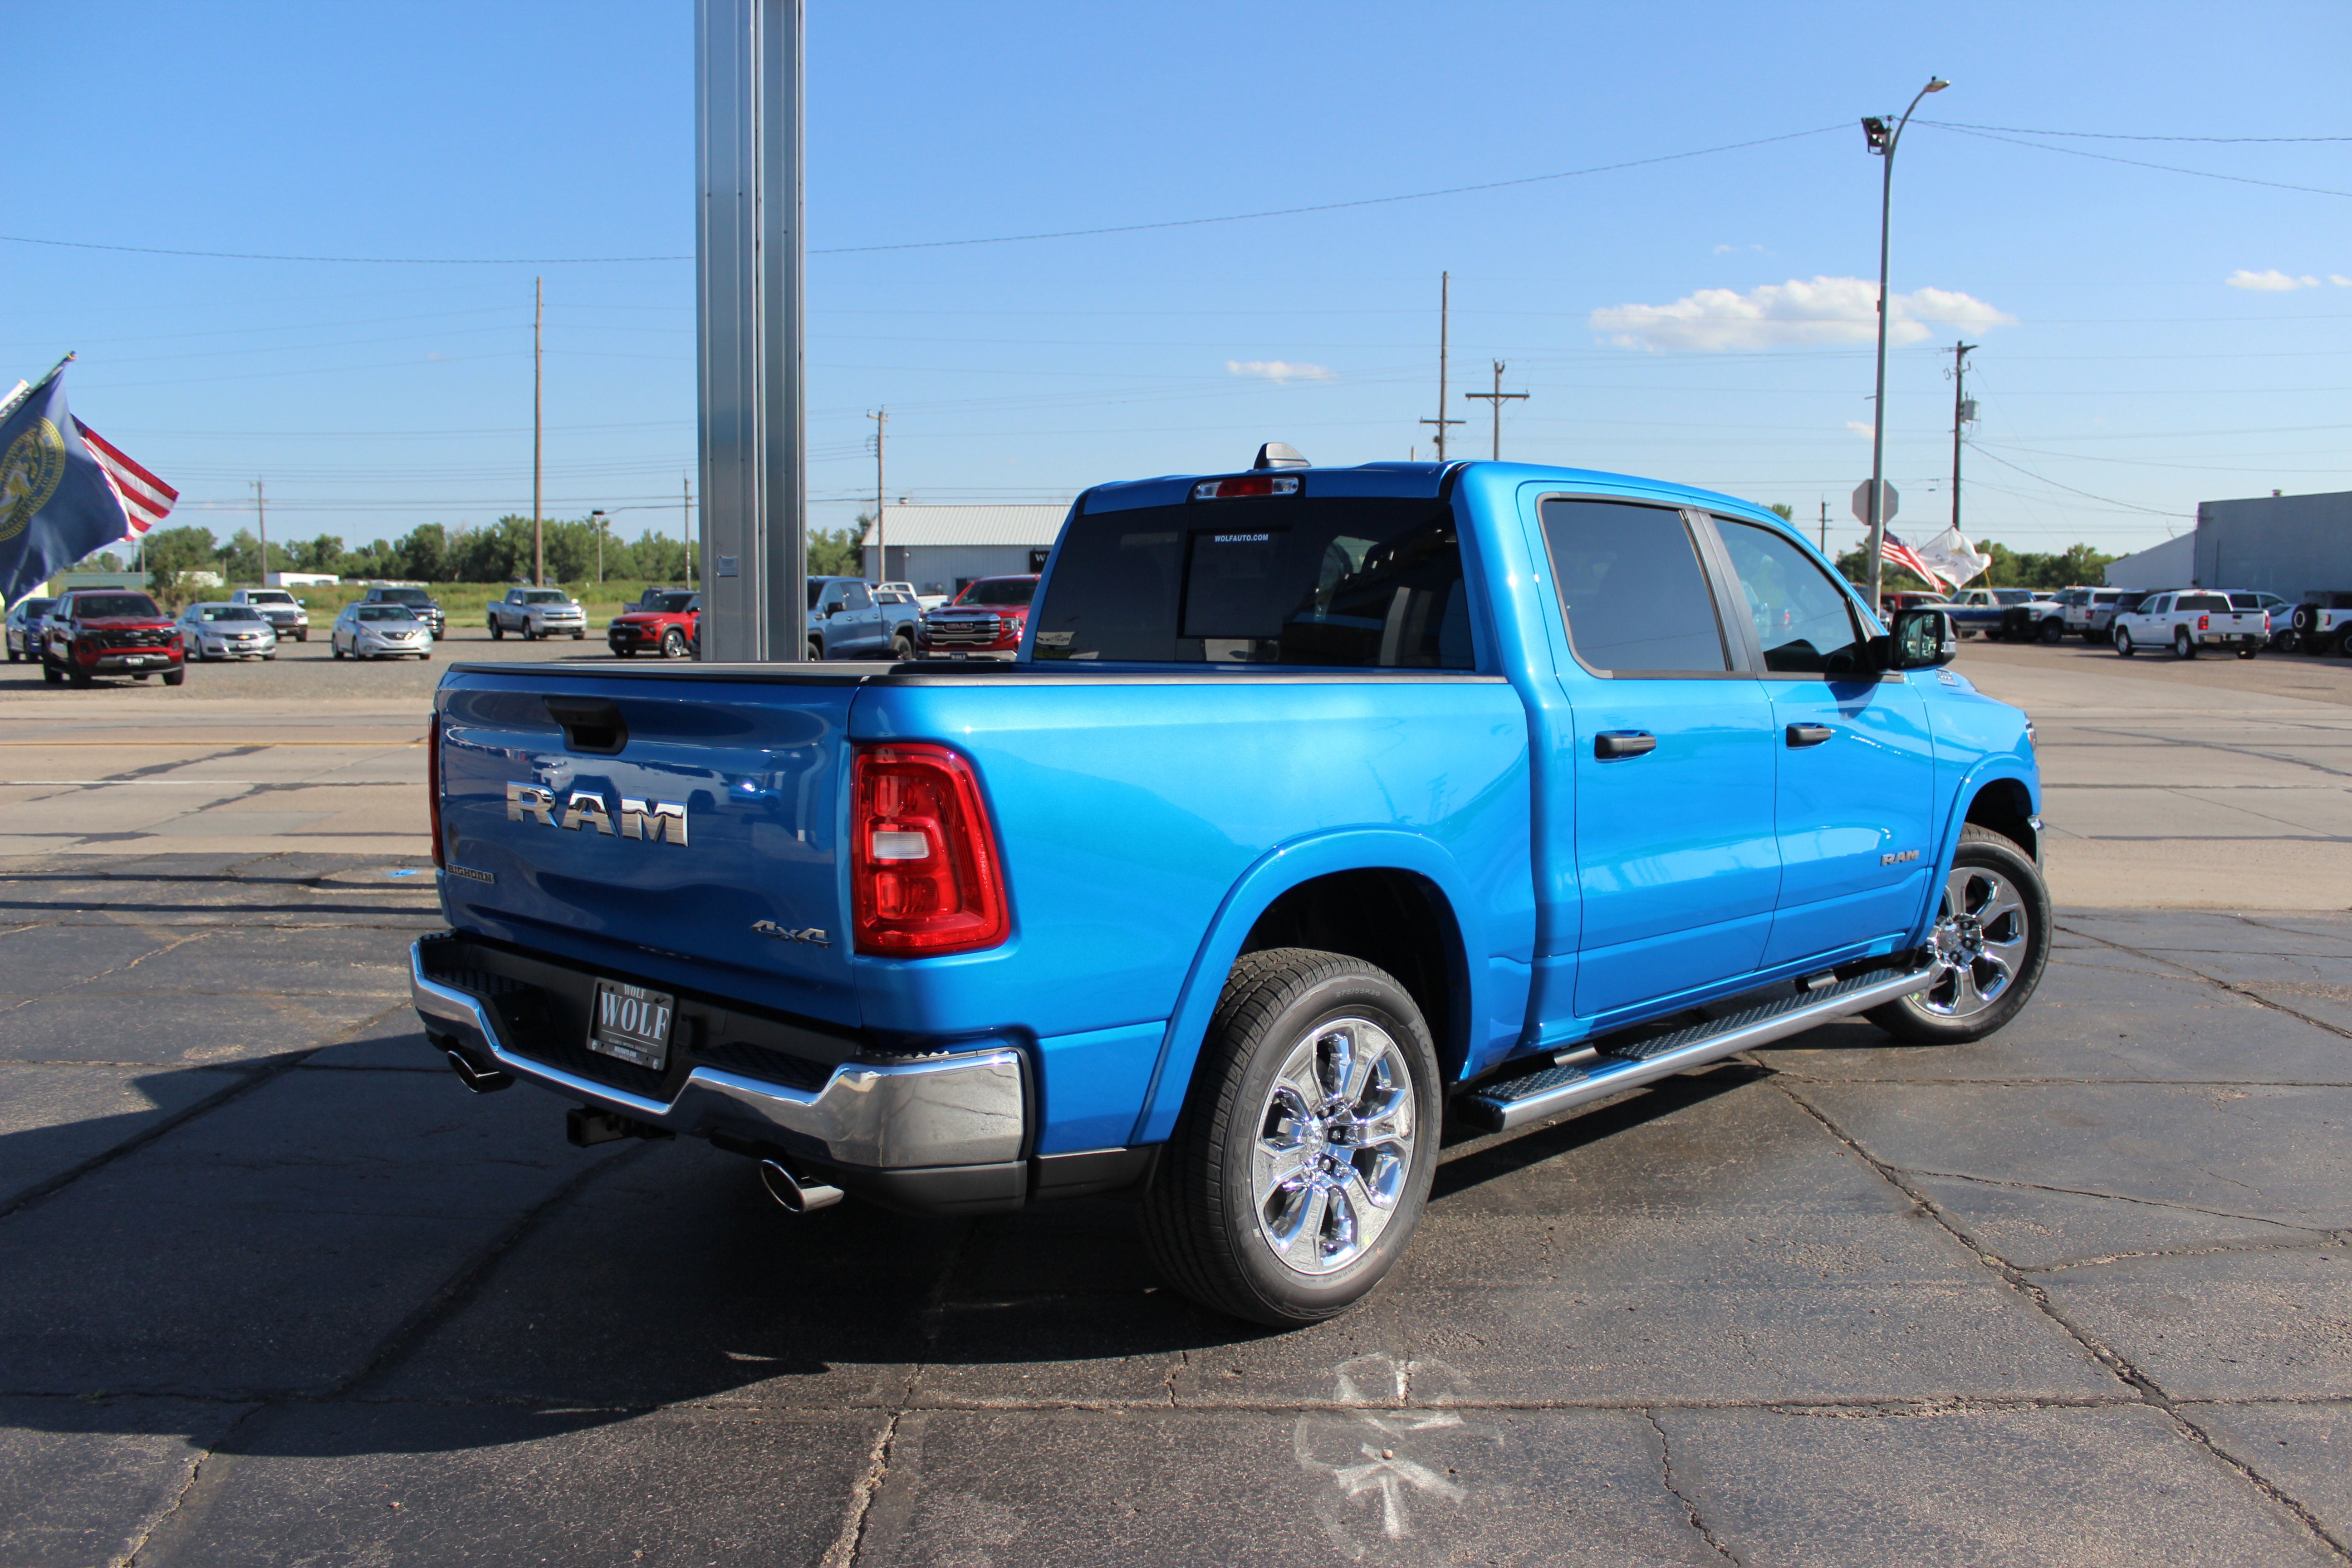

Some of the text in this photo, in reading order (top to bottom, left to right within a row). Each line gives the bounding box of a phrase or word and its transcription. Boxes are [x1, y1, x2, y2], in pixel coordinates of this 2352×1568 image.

[507, 781, 688, 847] RAM
[1881, 850, 1919, 866] RAM
[624, 984, 646, 999] WOLF
[1336, 987, 1380, 998] 275/55R20
[602, 991, 670, 1040] WOLF
[1230, 1065, 1269, 1250] NEXEN
